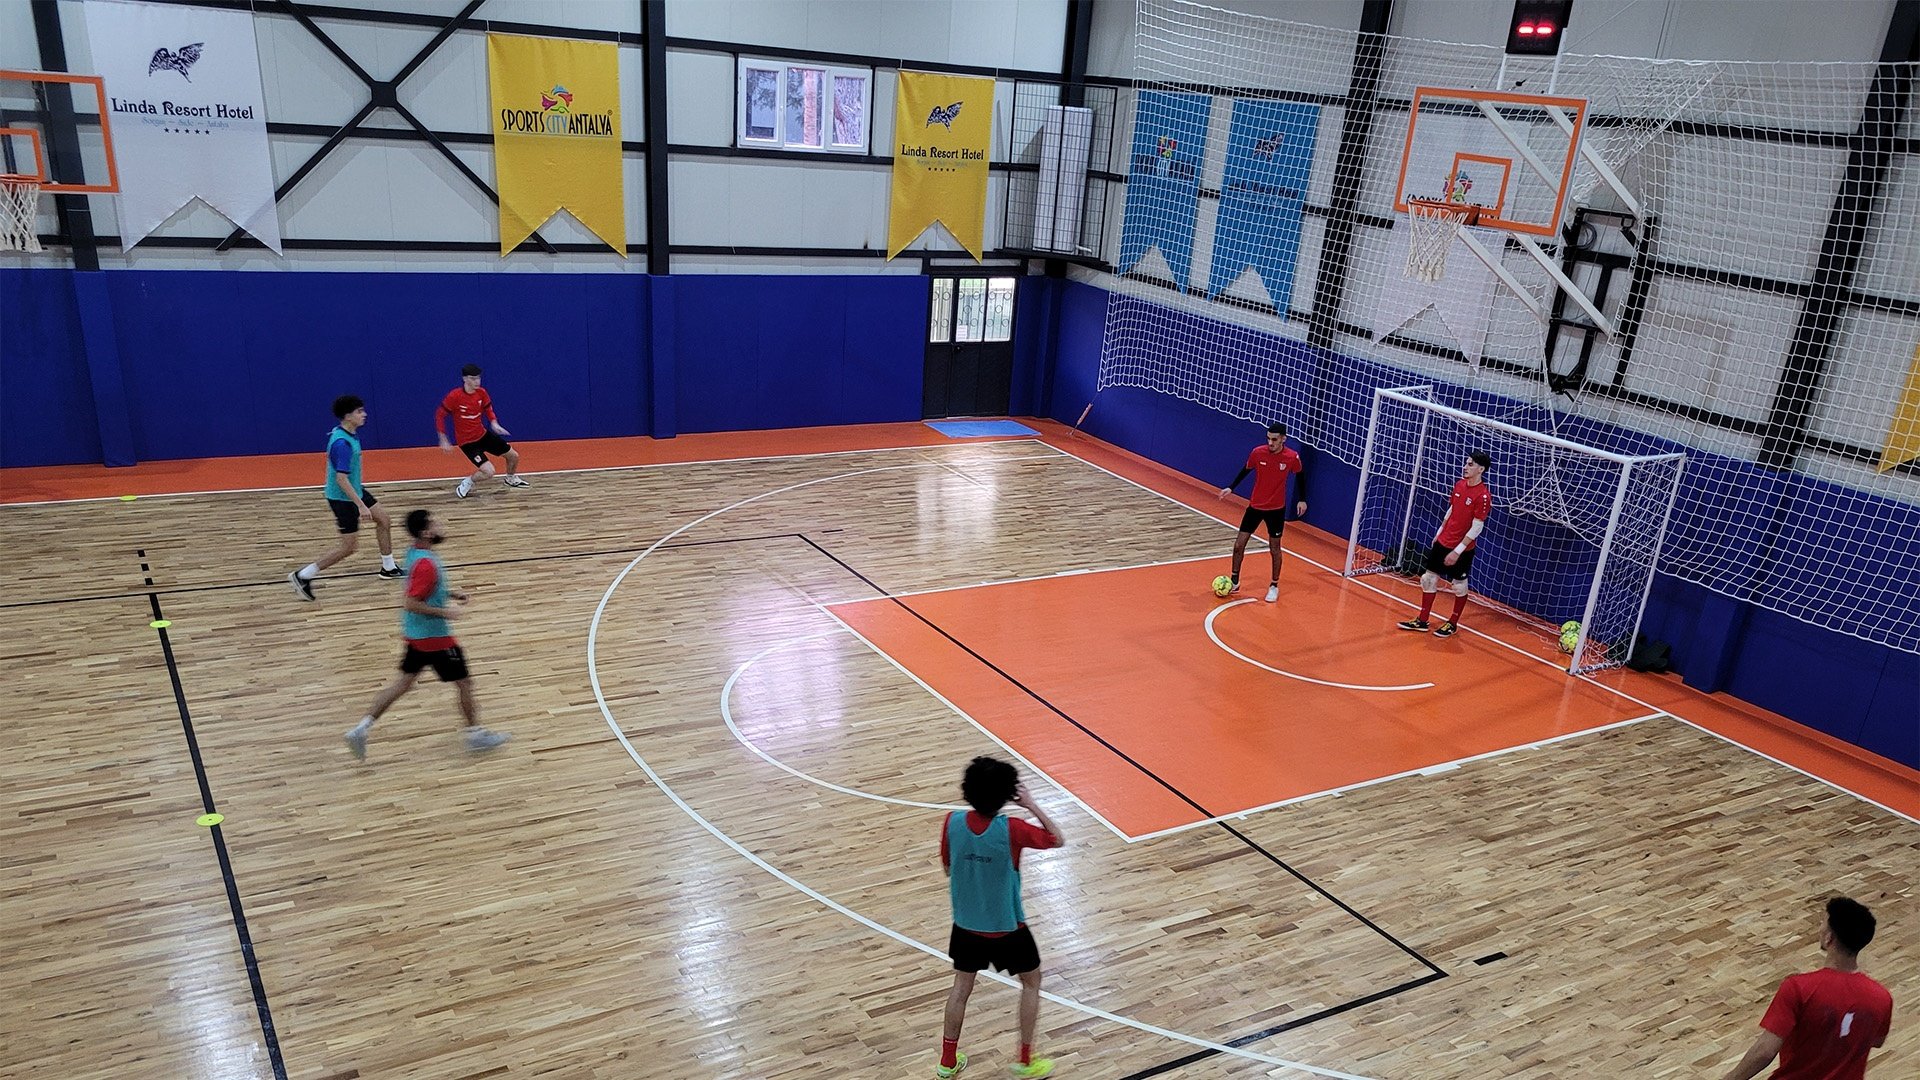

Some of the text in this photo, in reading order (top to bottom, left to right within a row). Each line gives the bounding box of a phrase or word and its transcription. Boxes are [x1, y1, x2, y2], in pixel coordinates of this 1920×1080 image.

[111, 98, 254, 119] Linda Resort Hotel
[501, 108, 545, 133] SPORTS
[546, 114, 567, 134] CITY
[901, 144, 984, 160] Linda Resort Hotel
